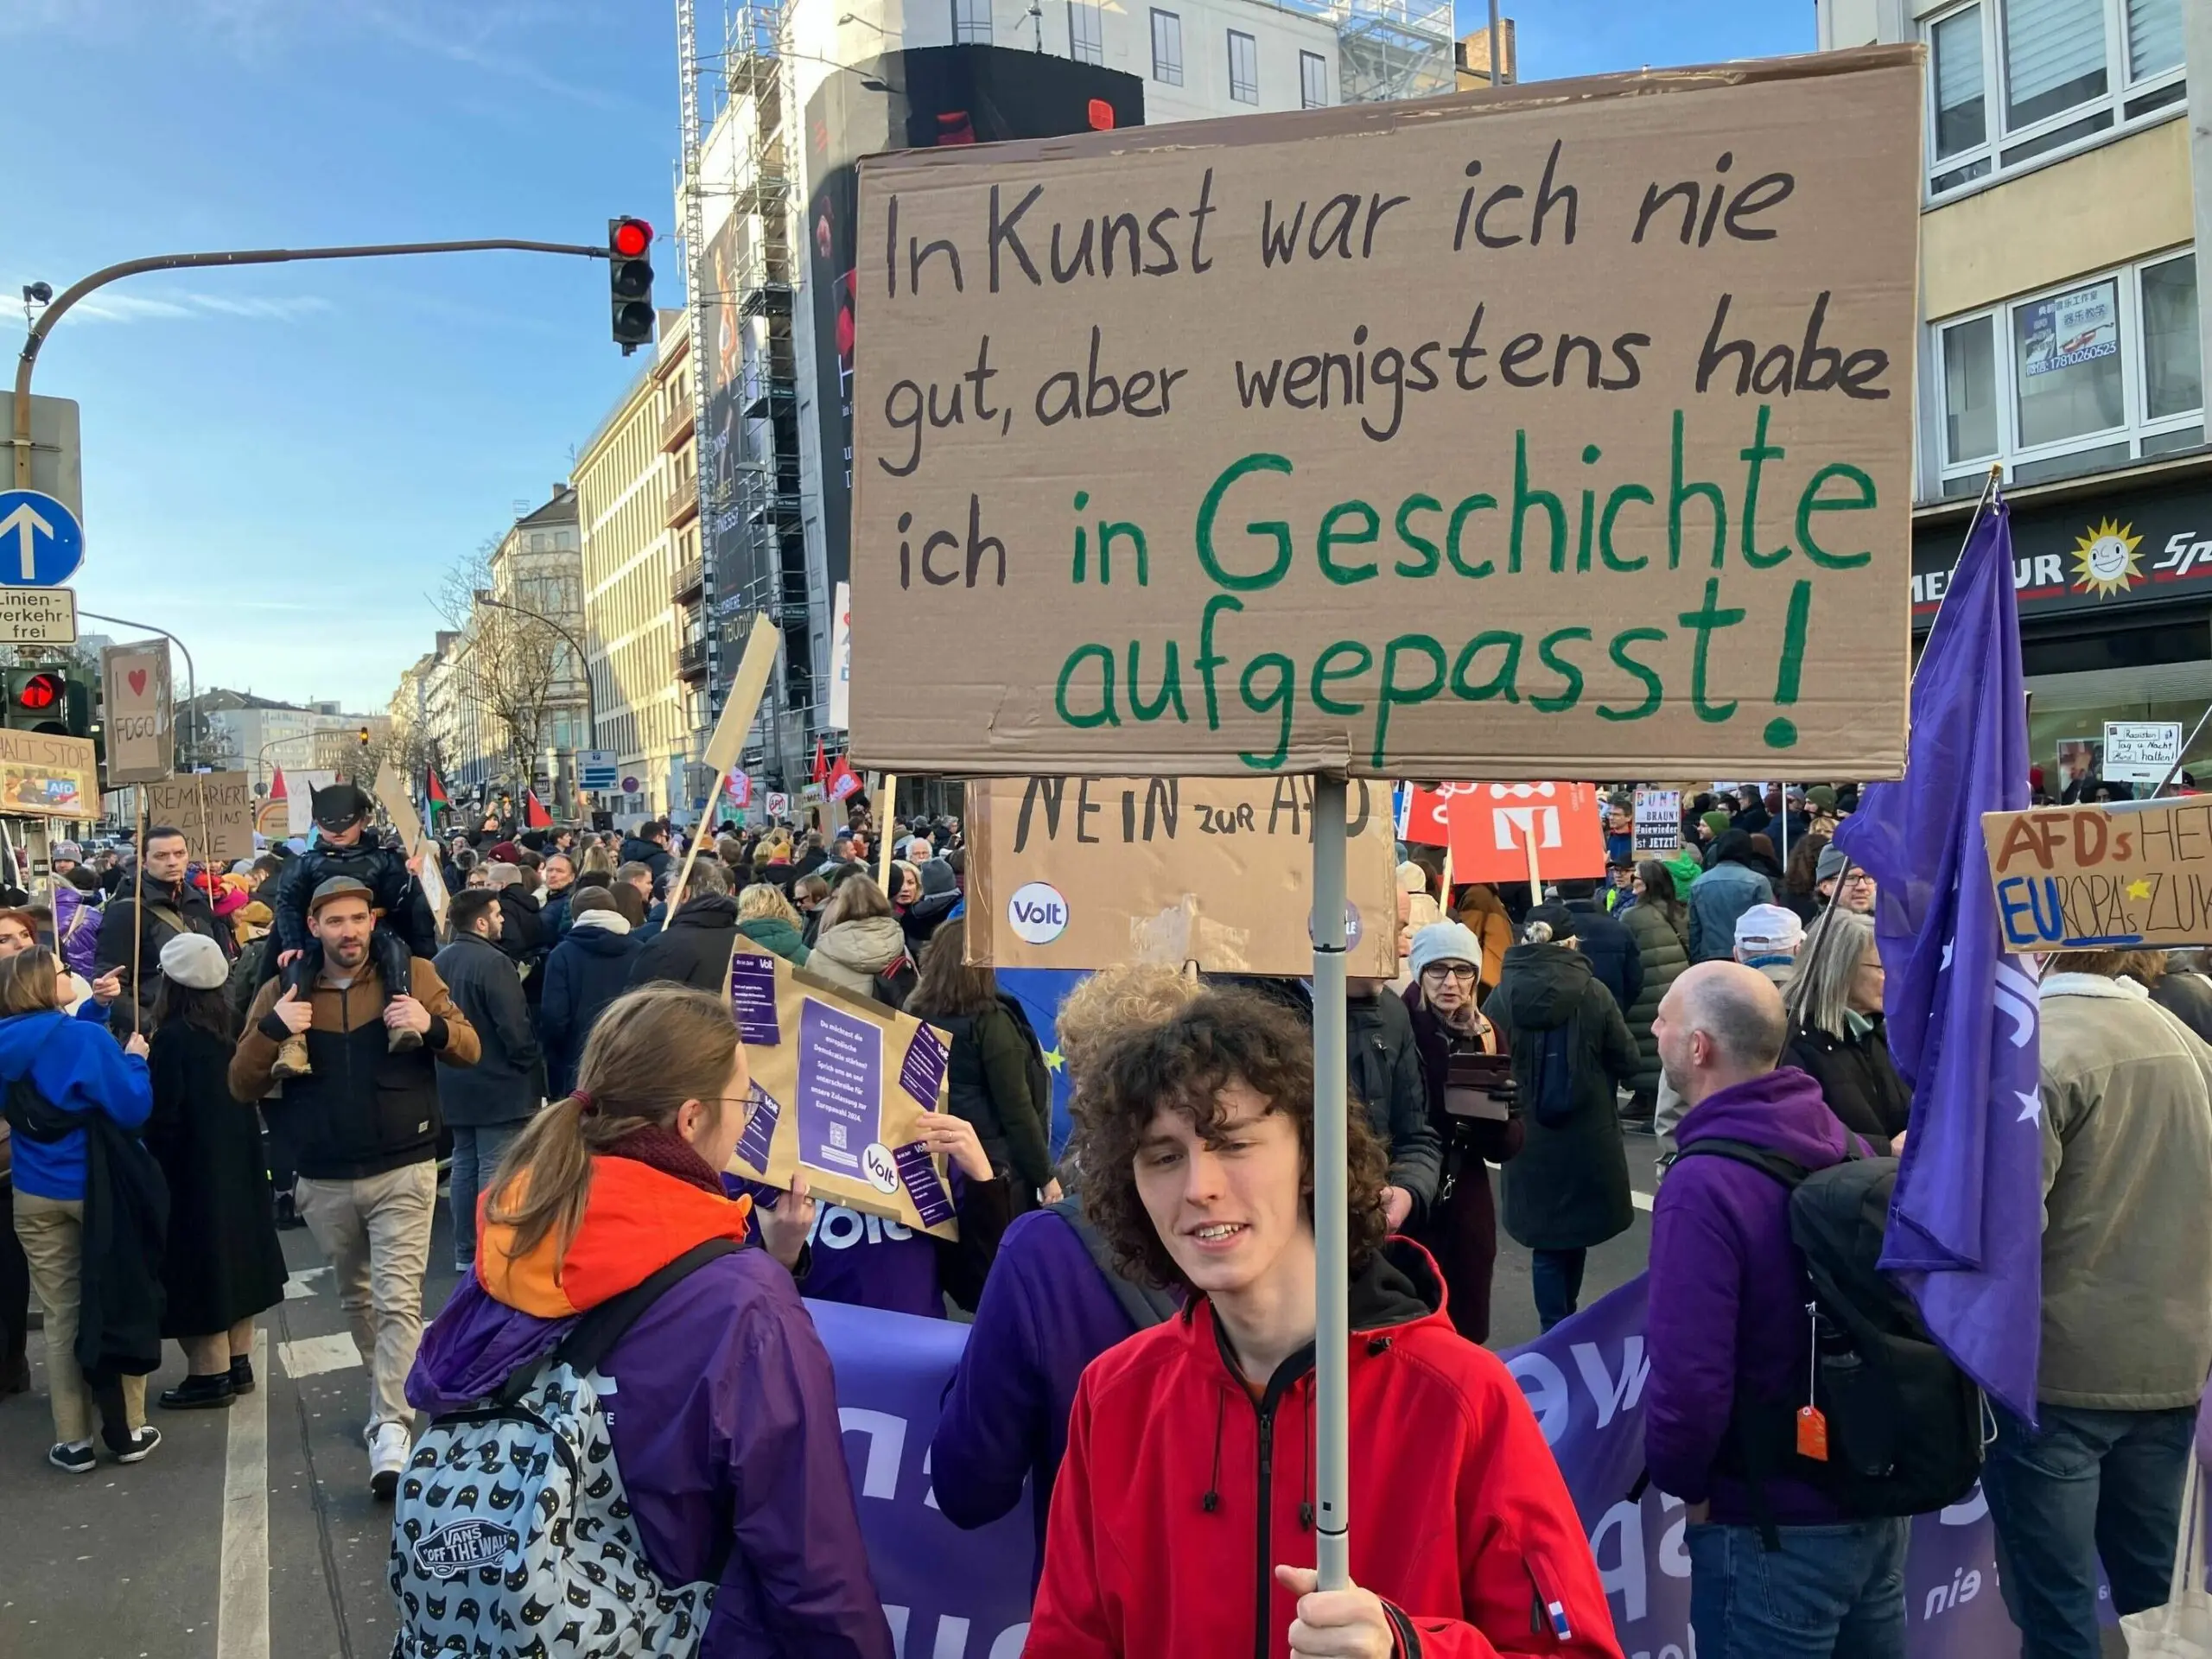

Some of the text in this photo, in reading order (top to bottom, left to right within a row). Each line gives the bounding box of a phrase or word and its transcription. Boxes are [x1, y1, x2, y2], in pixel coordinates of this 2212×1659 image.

[887, 139, 1795, 298] In Kunst war ich nie
[878, 289, 1891, 478] gut, aber wenigstens habe
[897, 404, 1878, 591] ich in Geschichte
[0, 592, 61, 606] inien-
[12, 625, 46, 638] frei
[1054, 577, 1812, 768] aufgepasst!
[114, 715, 156, 744] FDGO
[43, 741, 91, 768] STOP
[2117, 741, 2132, 751] Tag
[2142, 749, 2175, 761] halten!
[49, 782, 74, 793] AfD
[1637, 791, 1679, 807] BUNT
[219, 810, 242, 826] INS
[1014, 776, 1180, 854] NEIN
[188, 831, 227, 856] NIE
[1649, 836, 1677, 849] JETZT!
[1013, 900, 1064, 925] Volt
[813, 1044, 845, 1062] Demokratie
[817, 1060, 835, 1073] Sprich
[816, 1100, 848, 1118] Europawahl
[868, 1149, 895, 1187] Volt
[442, 1524, 482, 1547] VANS
[446, 1540, 480, 1561] THE
